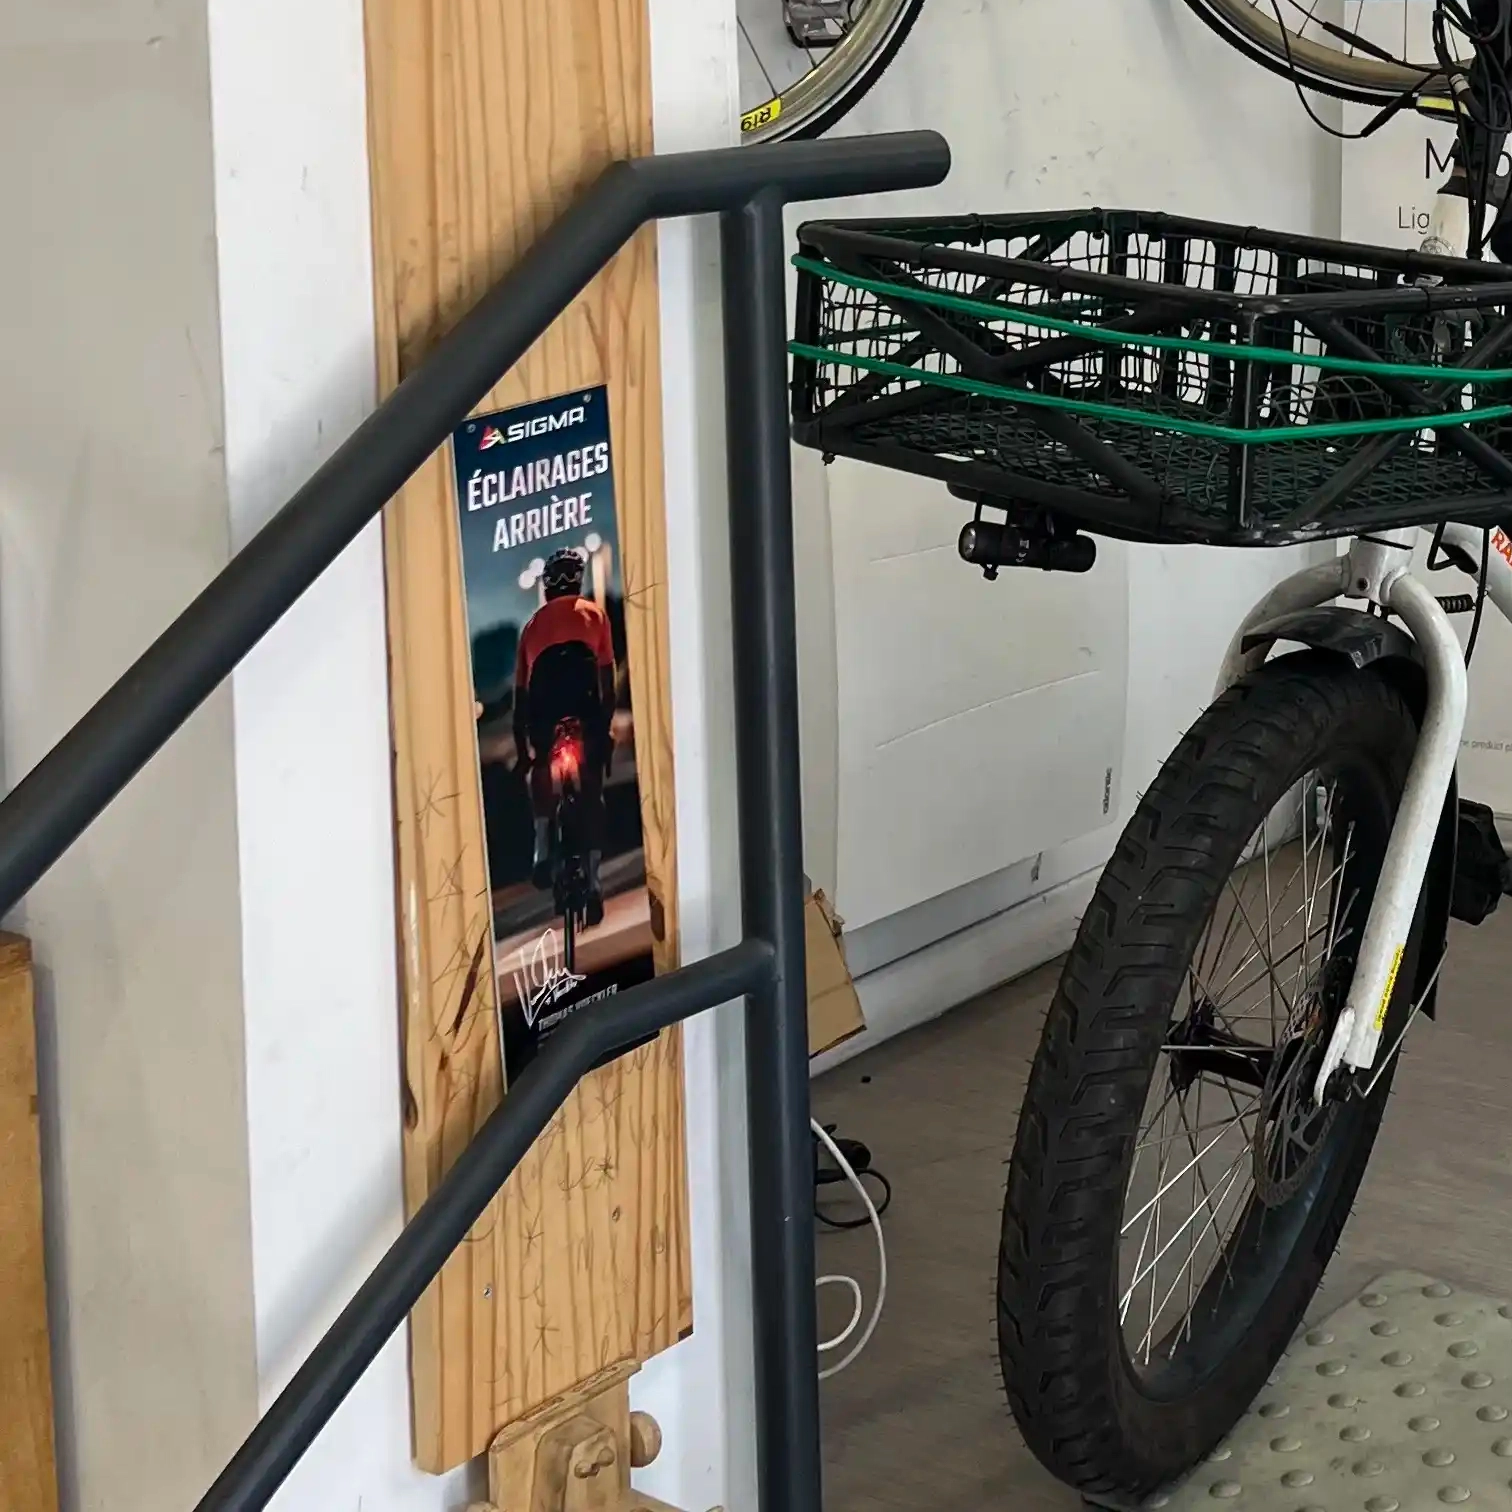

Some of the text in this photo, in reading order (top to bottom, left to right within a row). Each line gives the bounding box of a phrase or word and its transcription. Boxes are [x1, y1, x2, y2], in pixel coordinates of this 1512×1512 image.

[507, 406, 585, 443] SIGMA
[467, 442, 609, 512] ÉCLAIRAGES
[492, 492, 593, 553] ARRIÈRE
[1471, 739, 1503, 751] product
